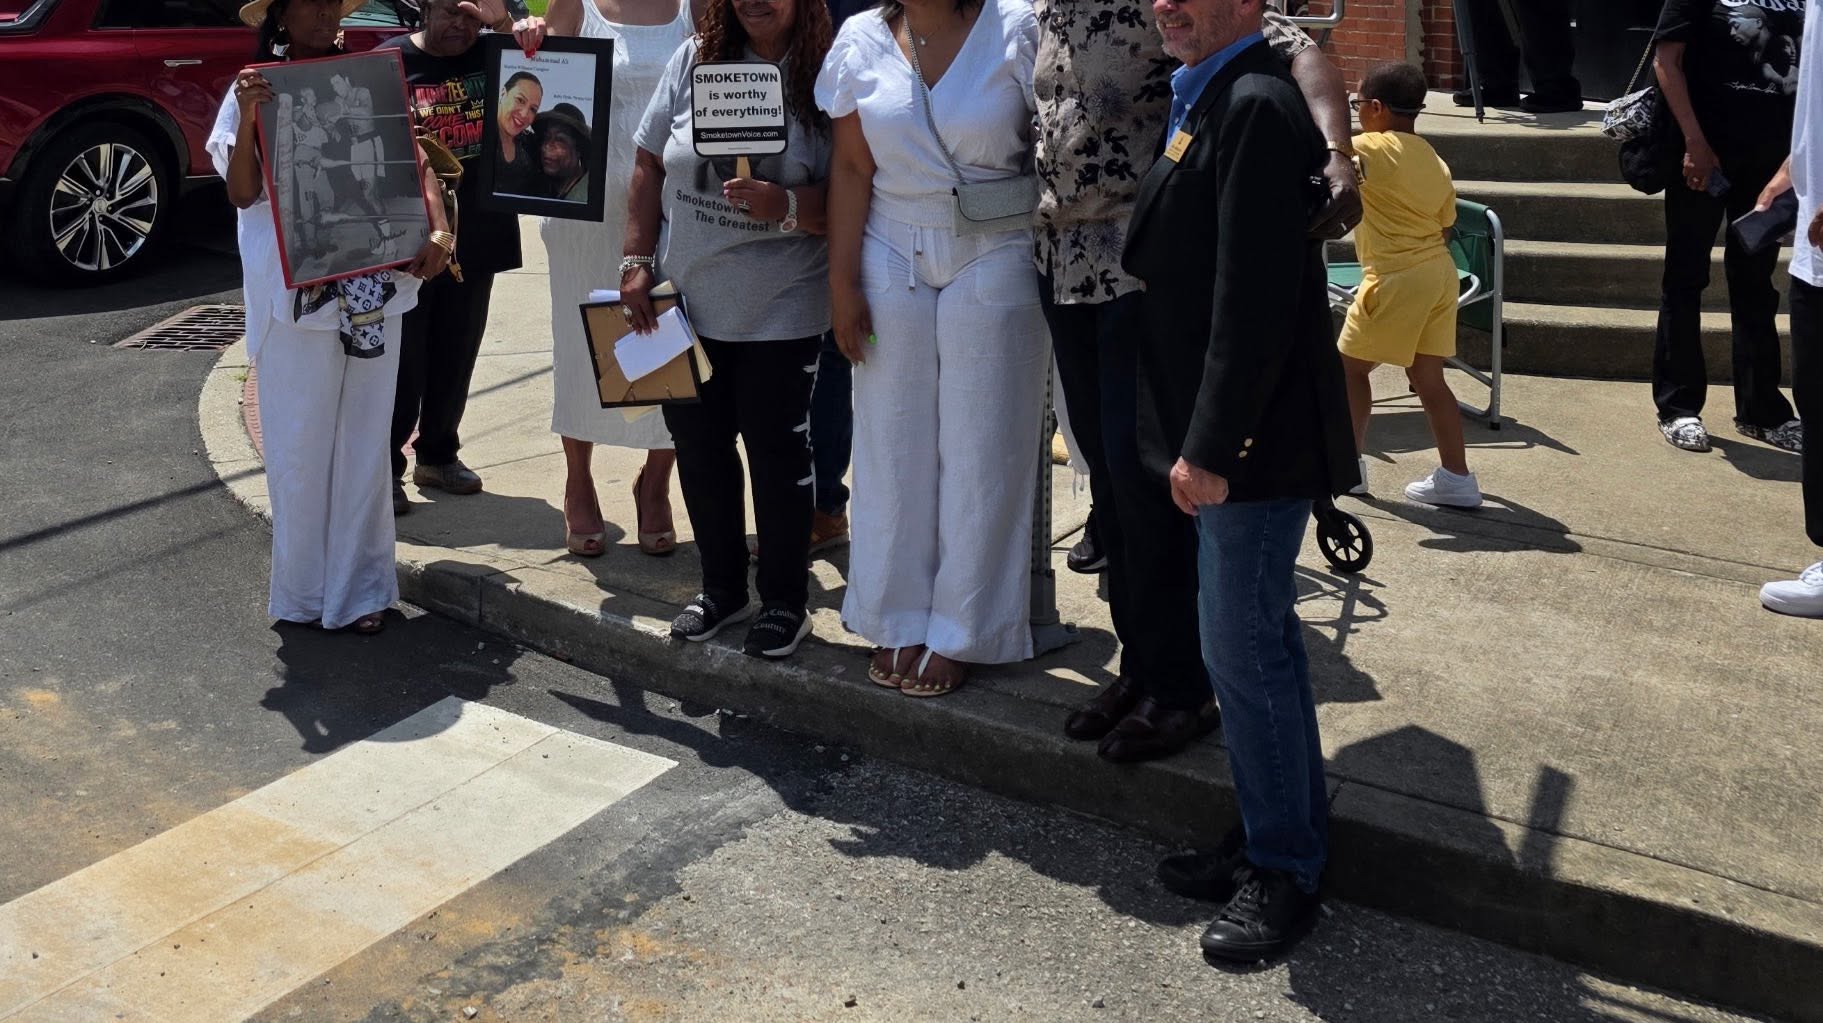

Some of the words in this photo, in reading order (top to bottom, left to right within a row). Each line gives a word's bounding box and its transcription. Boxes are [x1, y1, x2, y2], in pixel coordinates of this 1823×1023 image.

[695, 72, 778, 84] SMOKETOWN
[709, 90, 719, 100] is
[724, 89, 767, 101] worthy
[418, 106, 435, 118] WE
[695, 107, 708, 117] of
[712, 105, 782, 118] everything!
[700, 130, 779, 140] SmoketownVoice.com
[695, 210, 715, 224] The
[718, 216, 770, 232] Greatest
